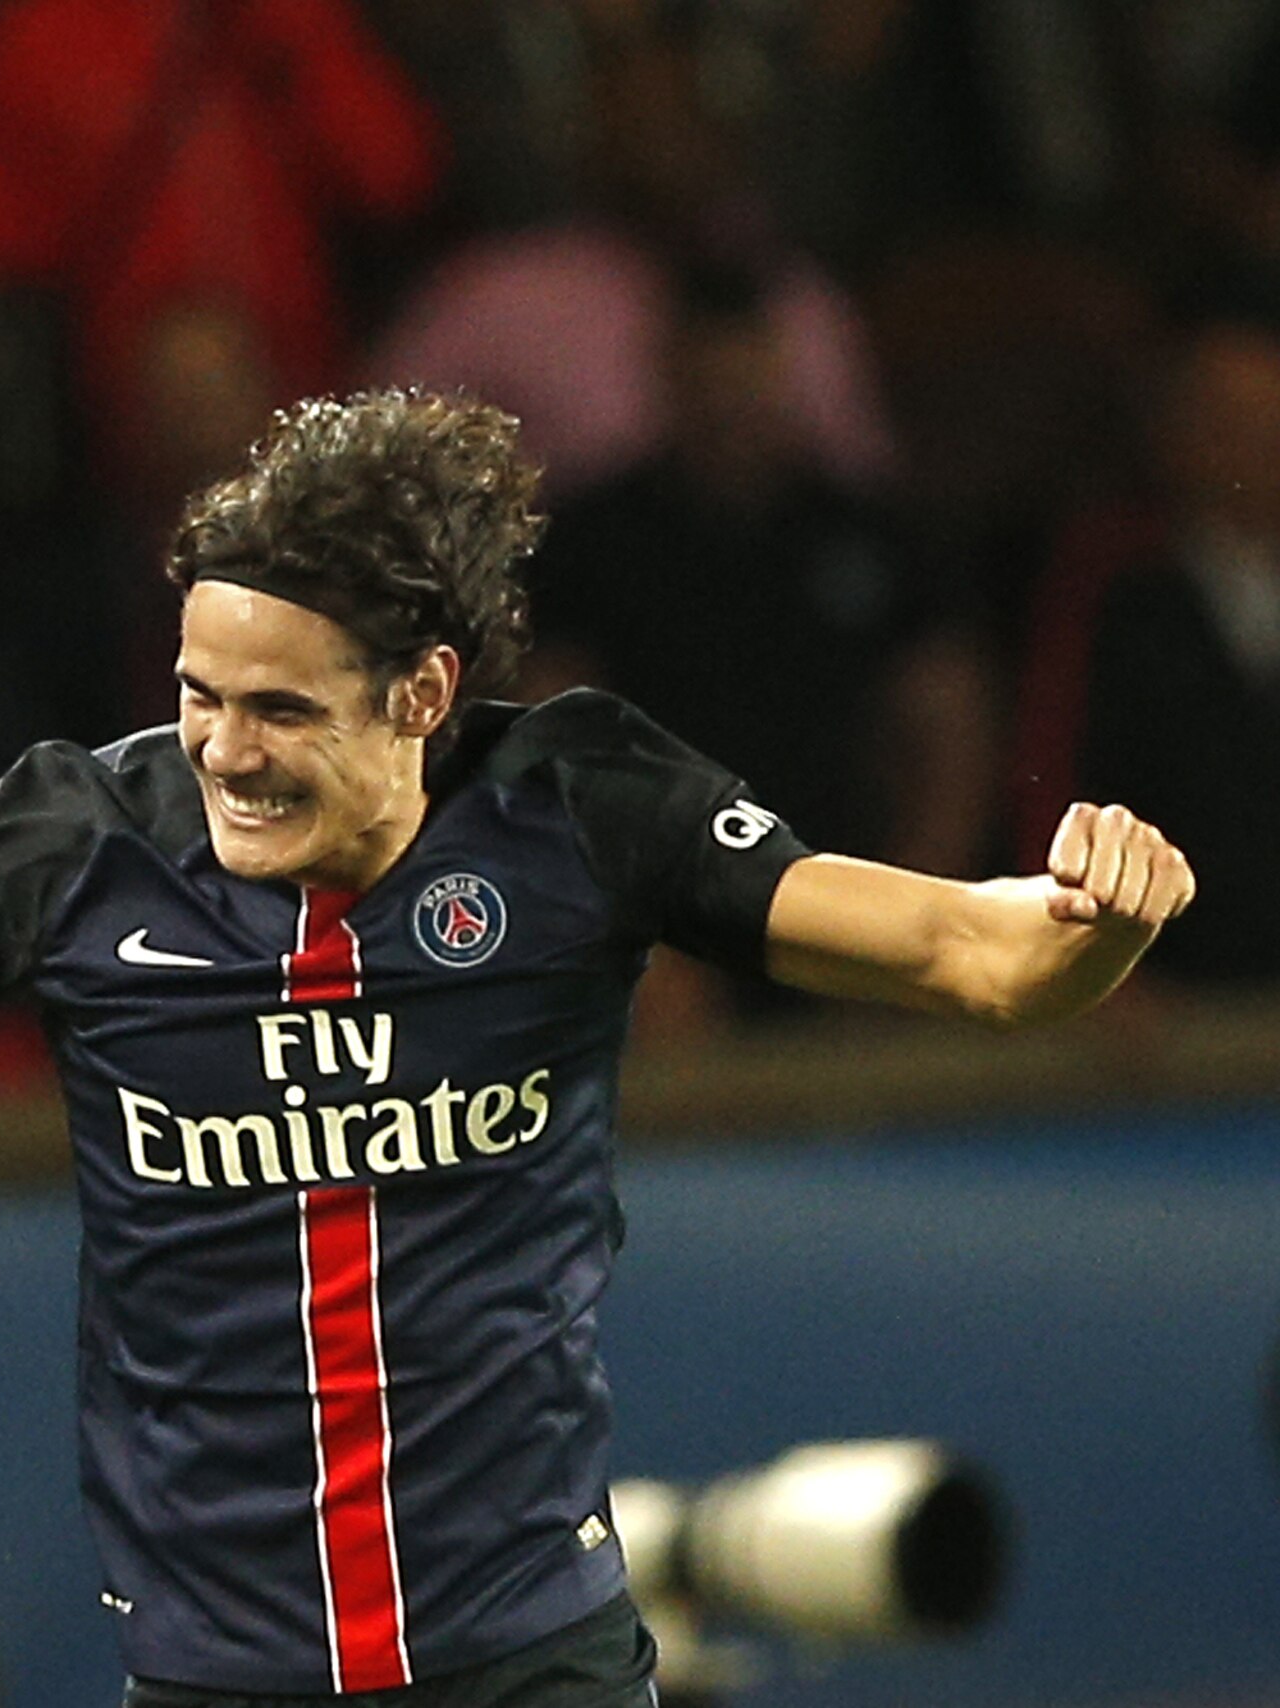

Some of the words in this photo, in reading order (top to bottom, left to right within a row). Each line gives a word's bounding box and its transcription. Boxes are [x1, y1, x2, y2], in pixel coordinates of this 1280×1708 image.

[421, 878, 479, 909] PARIS
[257, 1009, 393, 1084] Fly
[118, 1069, 550, 1187] Emirates
